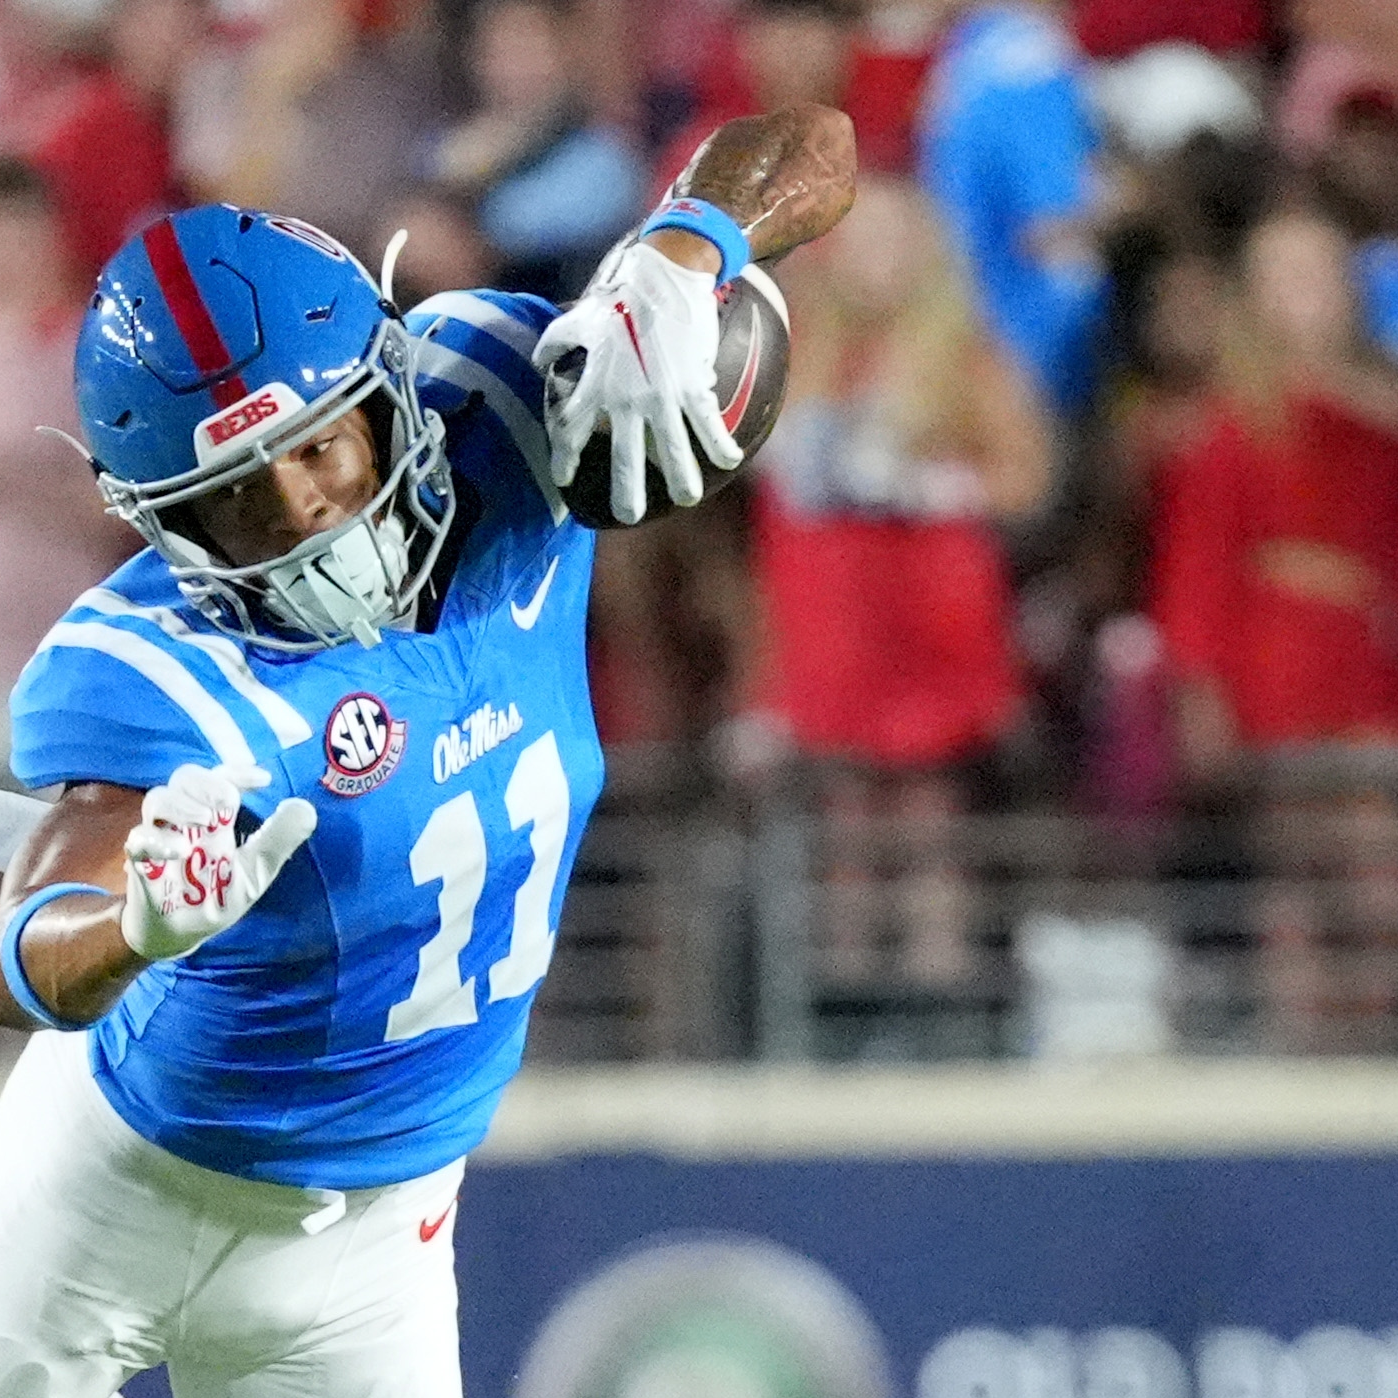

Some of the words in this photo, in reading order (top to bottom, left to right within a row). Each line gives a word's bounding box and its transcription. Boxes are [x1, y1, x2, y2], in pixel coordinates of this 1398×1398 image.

[206, 393, 279, 446] REBS
[330, 697, 387, 771] SEC
[335, 743, 401, 793] GRADUATE
[432, 724, 470, 785] Ole
[461, 702, 524, 762] Miss
[383, 729, 569, 1042] 11
